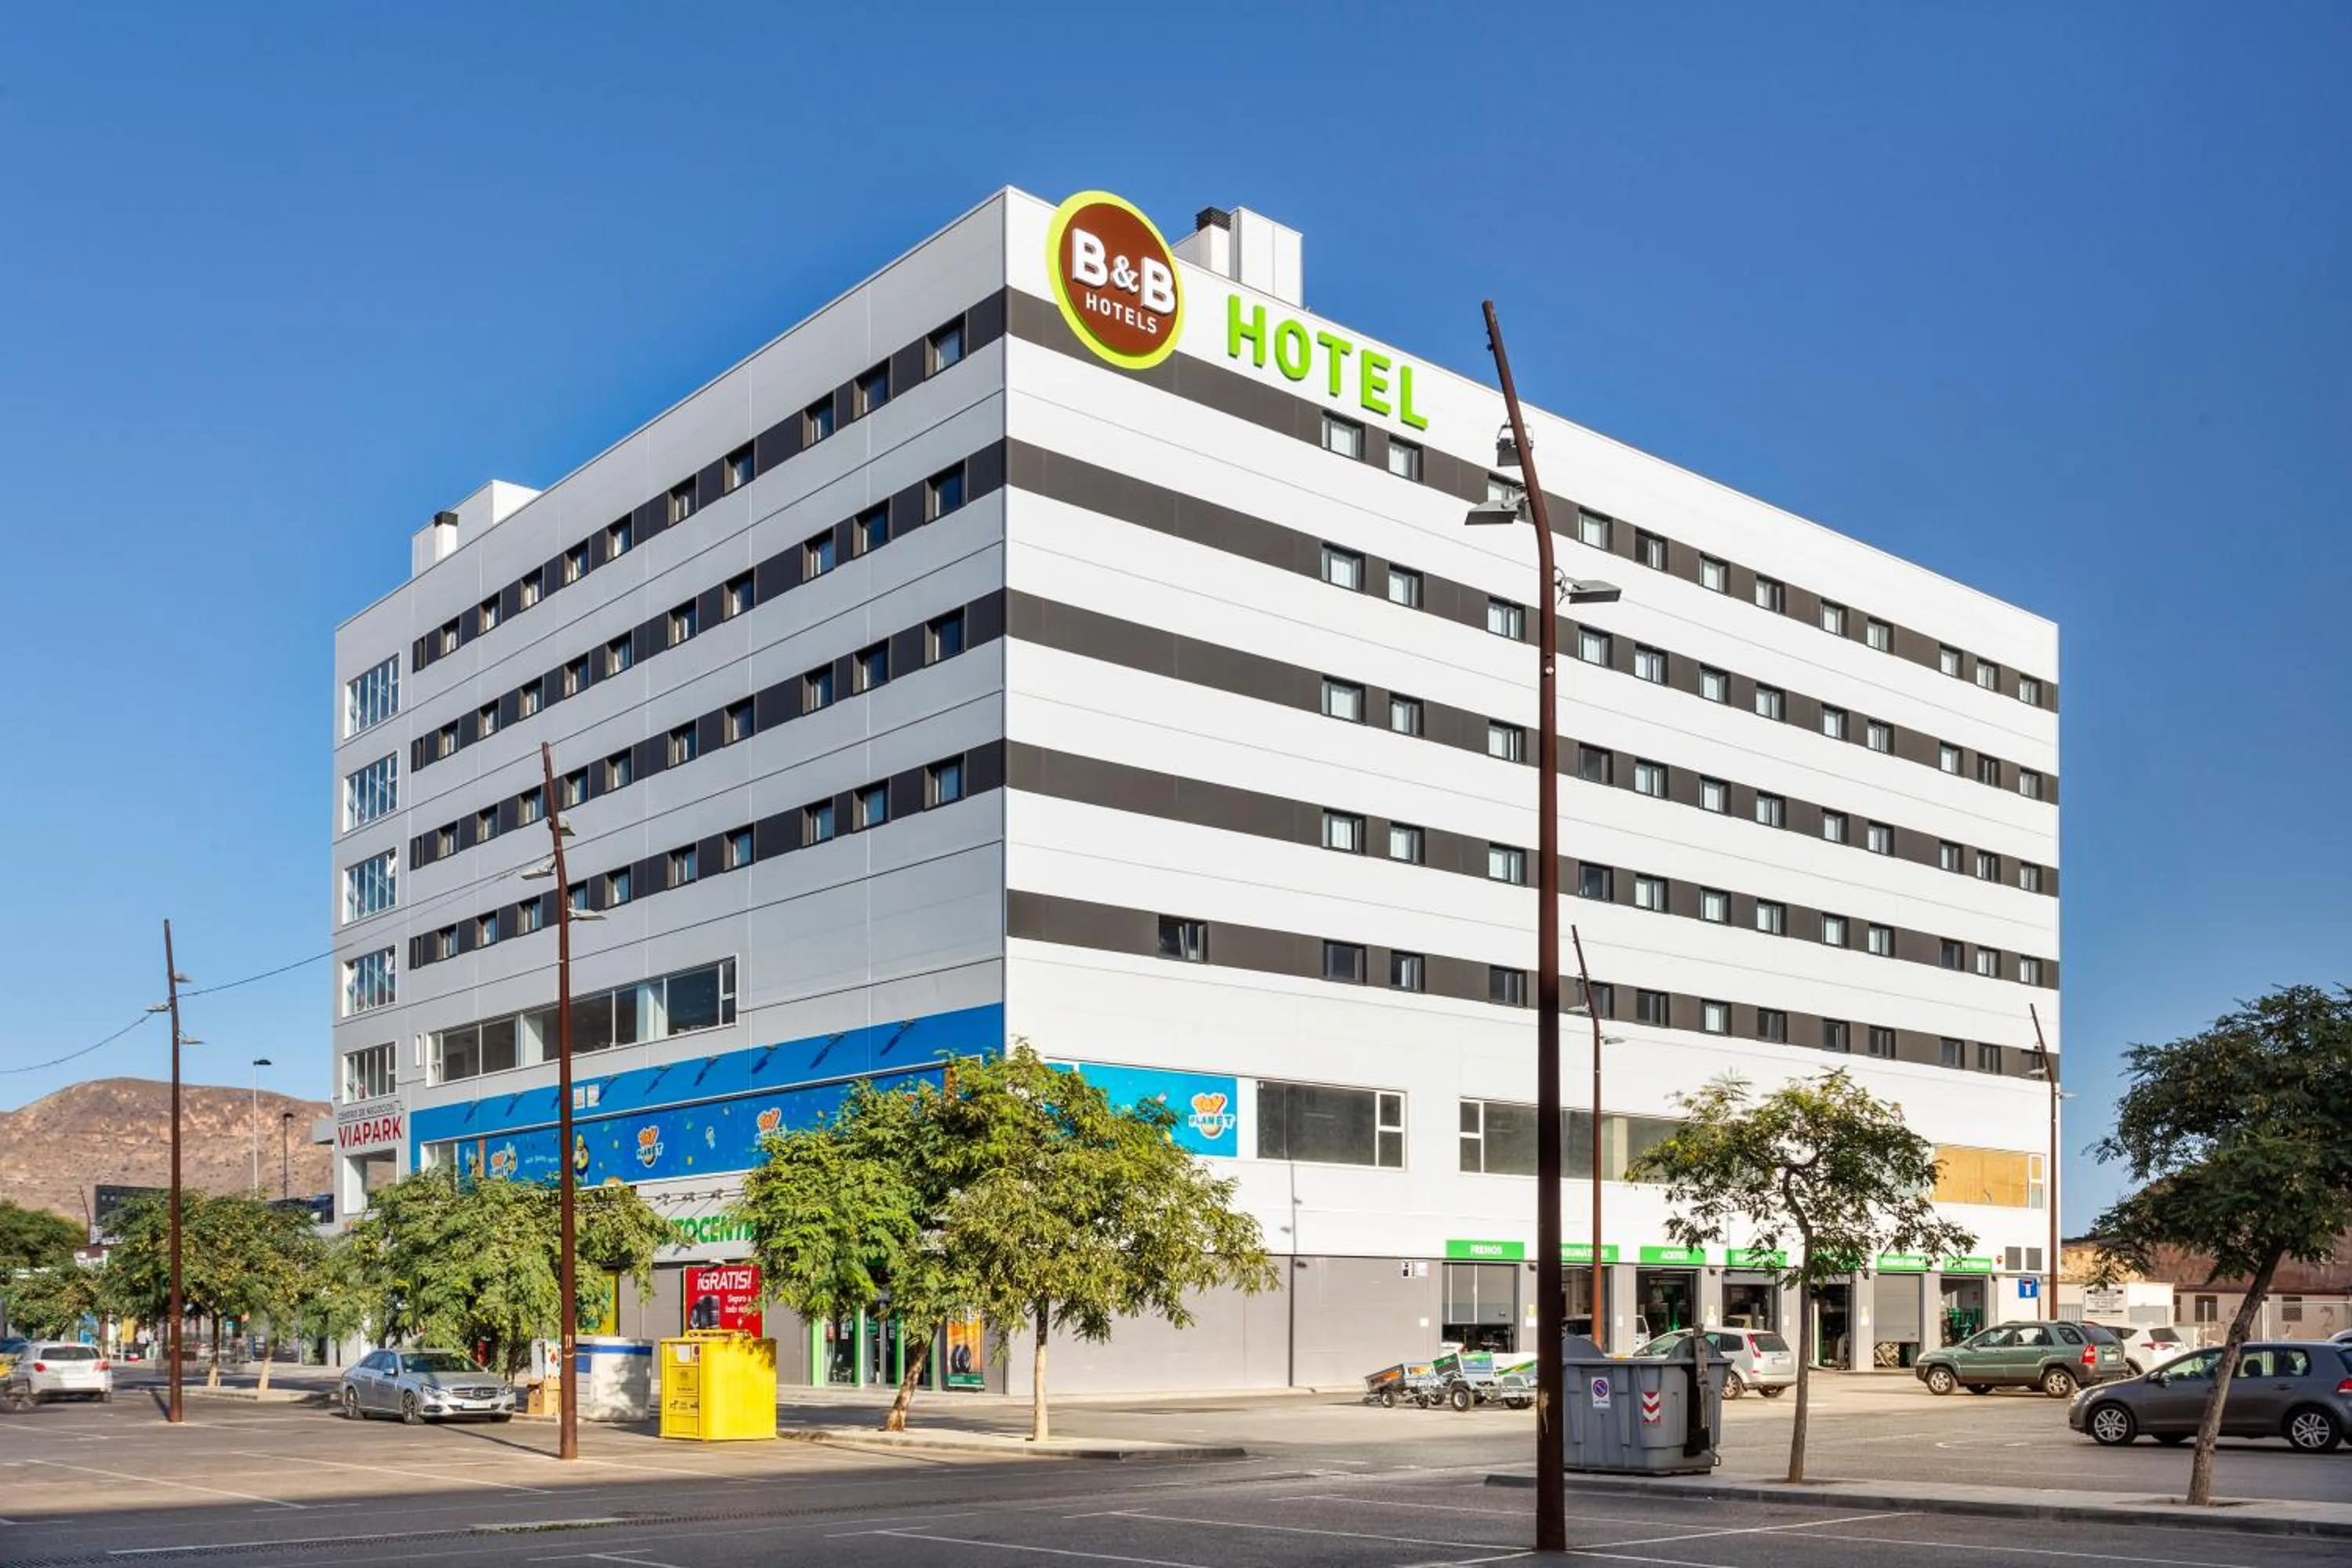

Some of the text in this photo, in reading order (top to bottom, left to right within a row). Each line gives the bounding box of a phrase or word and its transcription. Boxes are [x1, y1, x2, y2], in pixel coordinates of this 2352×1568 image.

[1072, 227, 1176, 315] B&B
[1086, 292, 1157, 334] HOTELS
[1228, 293, 1428, 430] HOTEL
[338, 1116, 402, 1149] VIAPARK
[697, 1272, 753, 1290] ¡GRATIS!
